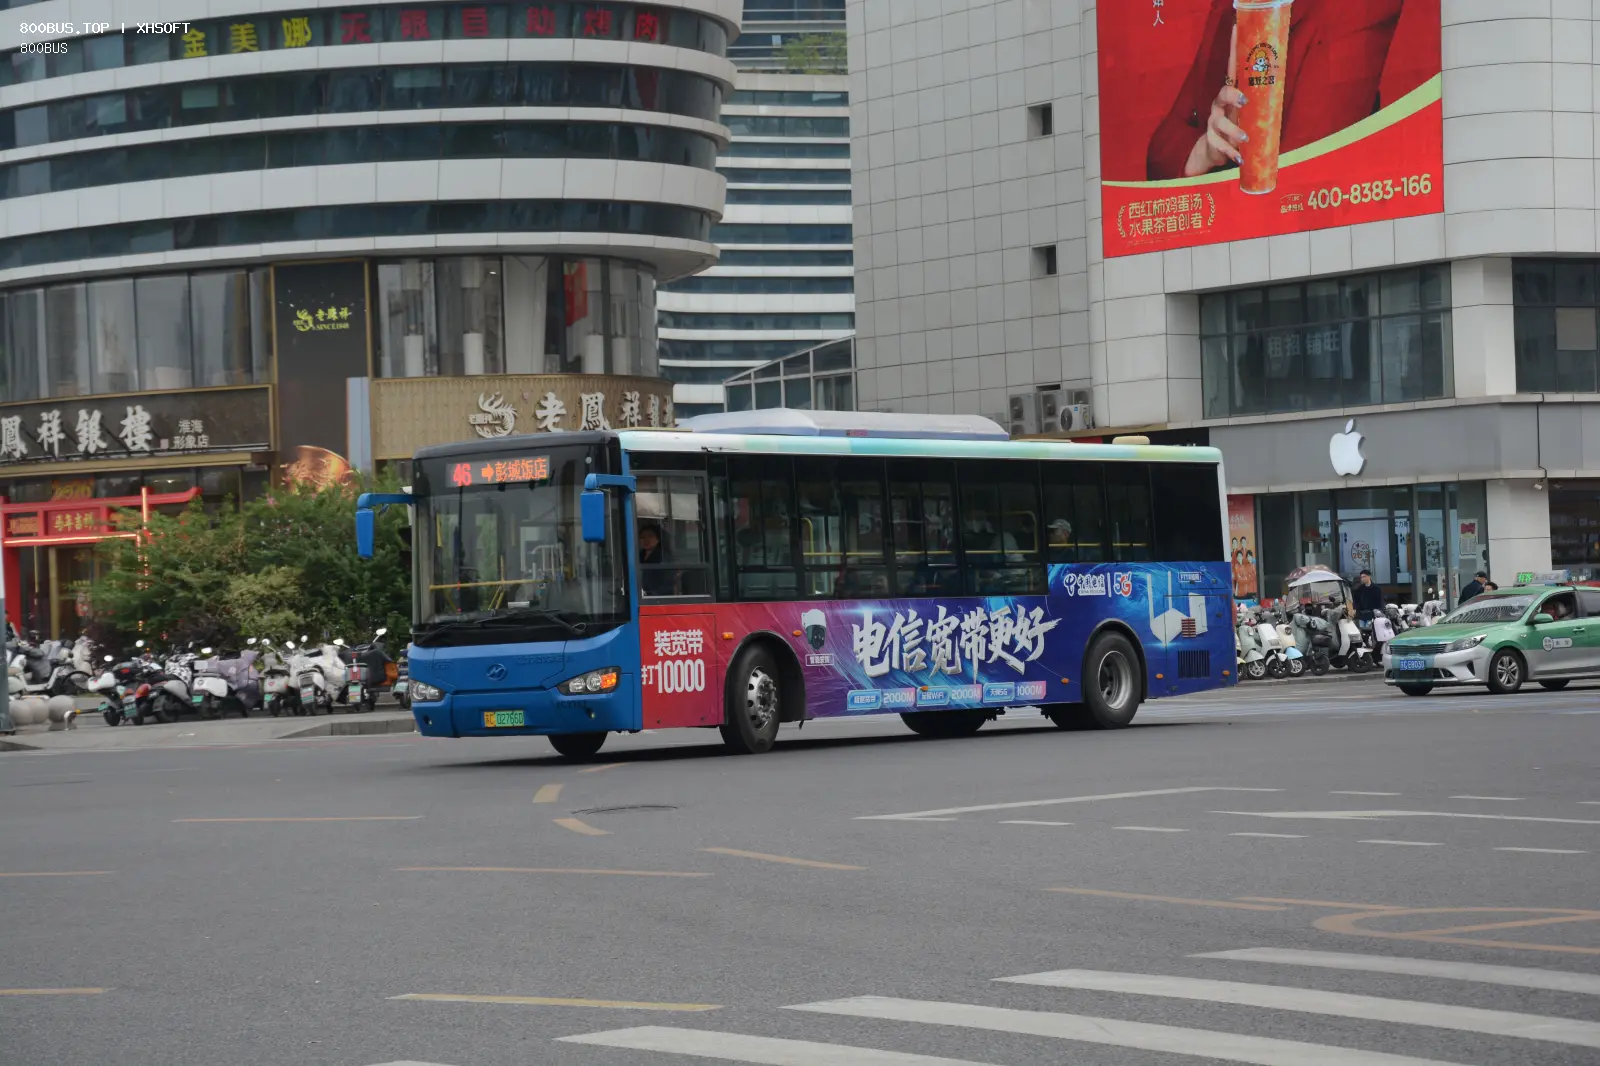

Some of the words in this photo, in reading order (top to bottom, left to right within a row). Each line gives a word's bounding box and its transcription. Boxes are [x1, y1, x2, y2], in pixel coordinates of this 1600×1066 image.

[1307, 173, 1432, 210] 400-8383-166
[1128, 193, 1203, 219] 西红柿鸡蛋汤
[1129, 212, 1203, 238] 水果茶首创者
[172, 434, 210, 450] 形象店
[452, 463, 473, 487] 46
[495, 457, 549, 482] 彭城饭店
[1077, 573, 1105, 589] 中国电信
[1113, 571, 1133, 597] 5G
[654, 629, 704, 657] 装宽带
[852, 604, 1063, 684] 电信宽带更好
[641, 659, 705, 694] 打10000
[883, 691, 914, 704] 2000M
[951, 687, 980, 700] 2000M
[1017, 685, 1042, 696] 1000M
